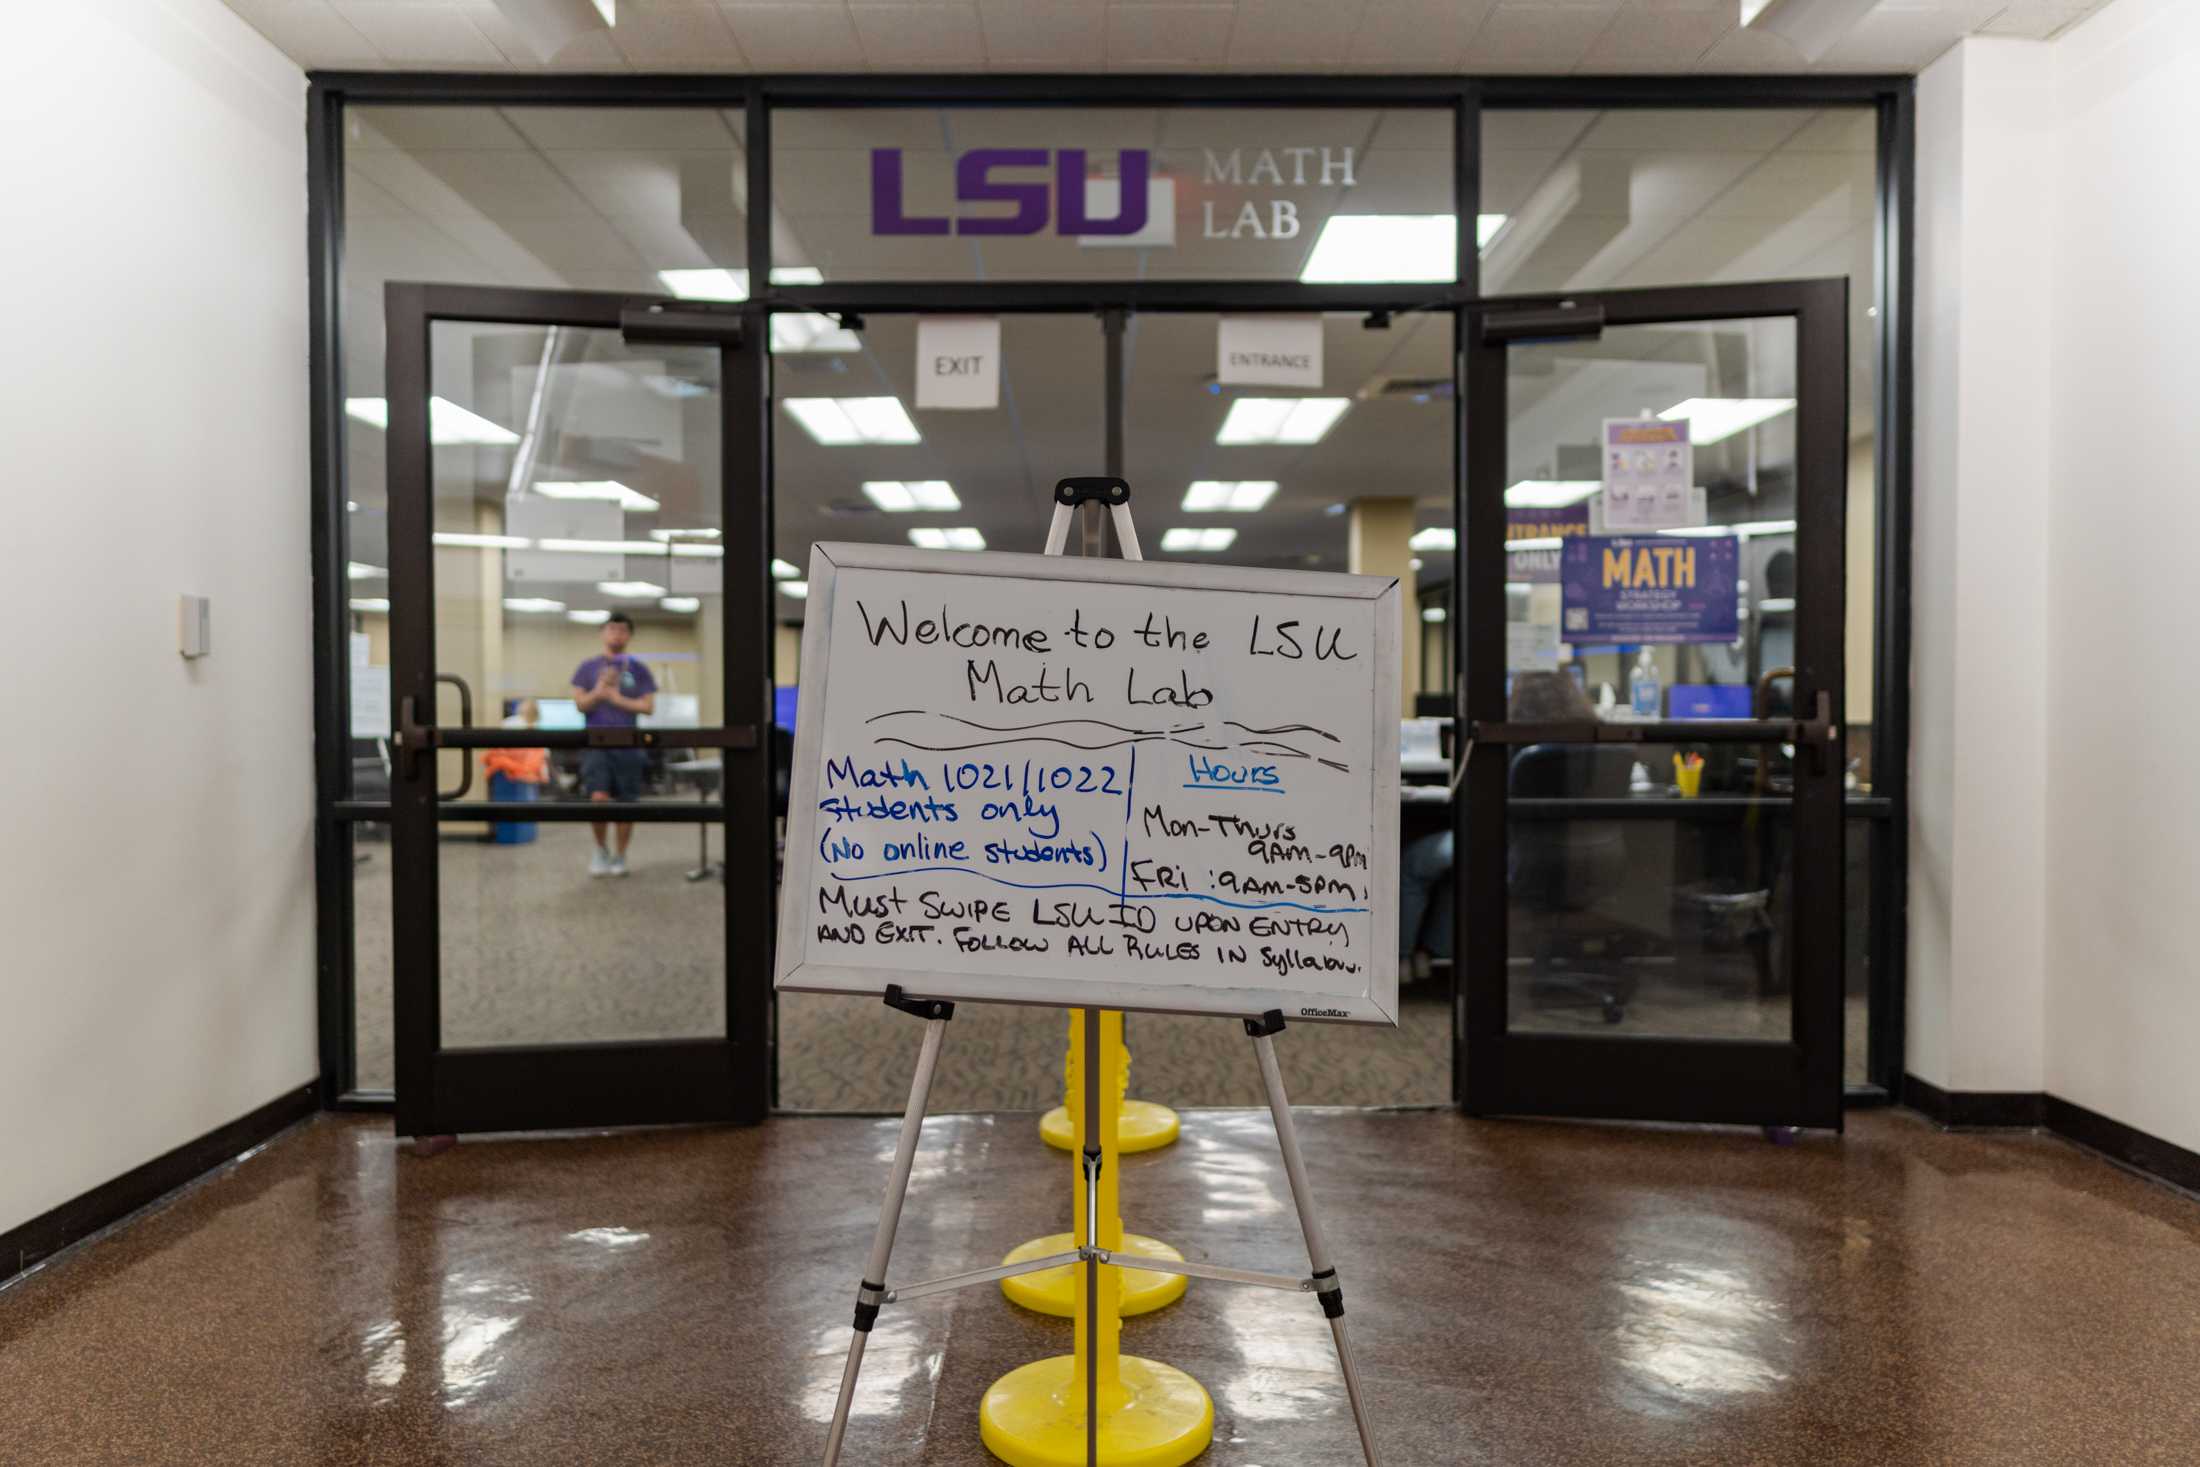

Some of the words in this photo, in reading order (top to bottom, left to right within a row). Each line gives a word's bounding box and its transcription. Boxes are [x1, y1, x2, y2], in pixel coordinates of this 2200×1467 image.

[1203, 147, 1357, 186] MATH
[871, 148, 1150, 236] LSU
[1203, 200, 1301, 239] LAB
[935, 355, 984, 376] EXIT
[1229, 352, 1311, 370] ENTRANCE
[1602, 546, 1696, 589] MATH
[856, 599, 1051, 653] Welcome
[1063, 608, 1115, 649] to
[1133, 612, 1211, 651] the
[1250, 615, 1358, 661] LSU
[966, 659, 1094, 705] Math
[1127, 667, 1214, 709] Lab
[827, 755, 929, 791] Math
[1189, 754, 1280, 786] Hours
[980, 796, 1060, 840] only
[820, 827, 865, 864] (No
[883, 831, 970, 862] online
[985, 831, 1108, 873] students)
[1033, 898, 1105, 928] LSU
[1108, 904, 1157, 934] ID
[1174, 911, 1241, 934] UPON
[817, 924, 866, 945] AND
[952, 926, 1050, 953] FOLLOW
[1067, 935, 1115, 957] ALL
[1122, 934, 1201, 961] RULES
[1217, 946, 1248, 964] IN
[1300, 1007, 1349, 1018] OfficeMax
